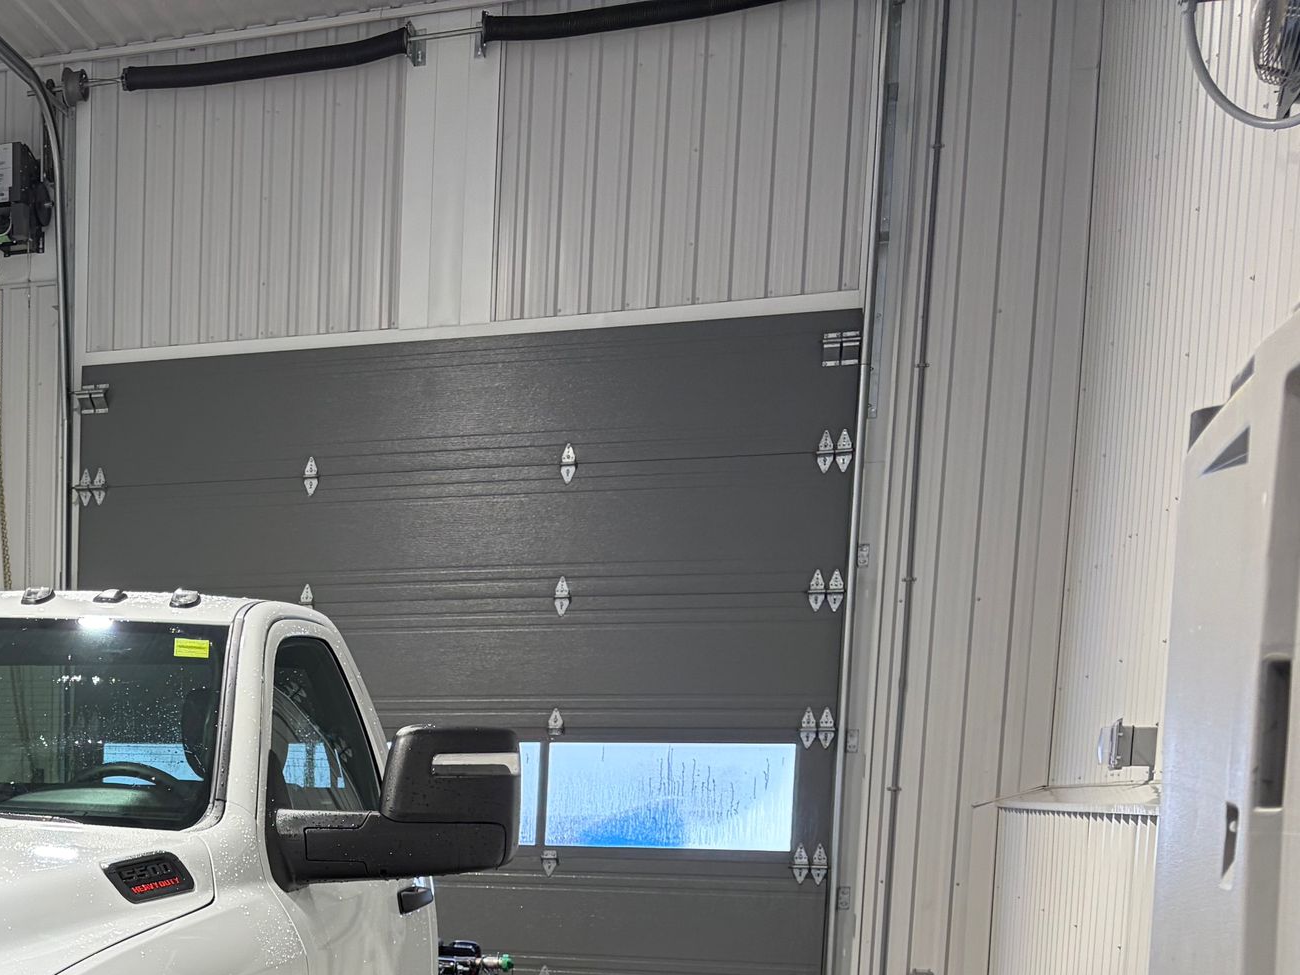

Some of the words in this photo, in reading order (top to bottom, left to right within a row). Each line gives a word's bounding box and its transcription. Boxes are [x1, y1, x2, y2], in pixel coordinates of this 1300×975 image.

[120, 861, 171, 881] 5500
[130, 881, 160, 894] HEAVY
[159, 876, 180, 889] DUTY
